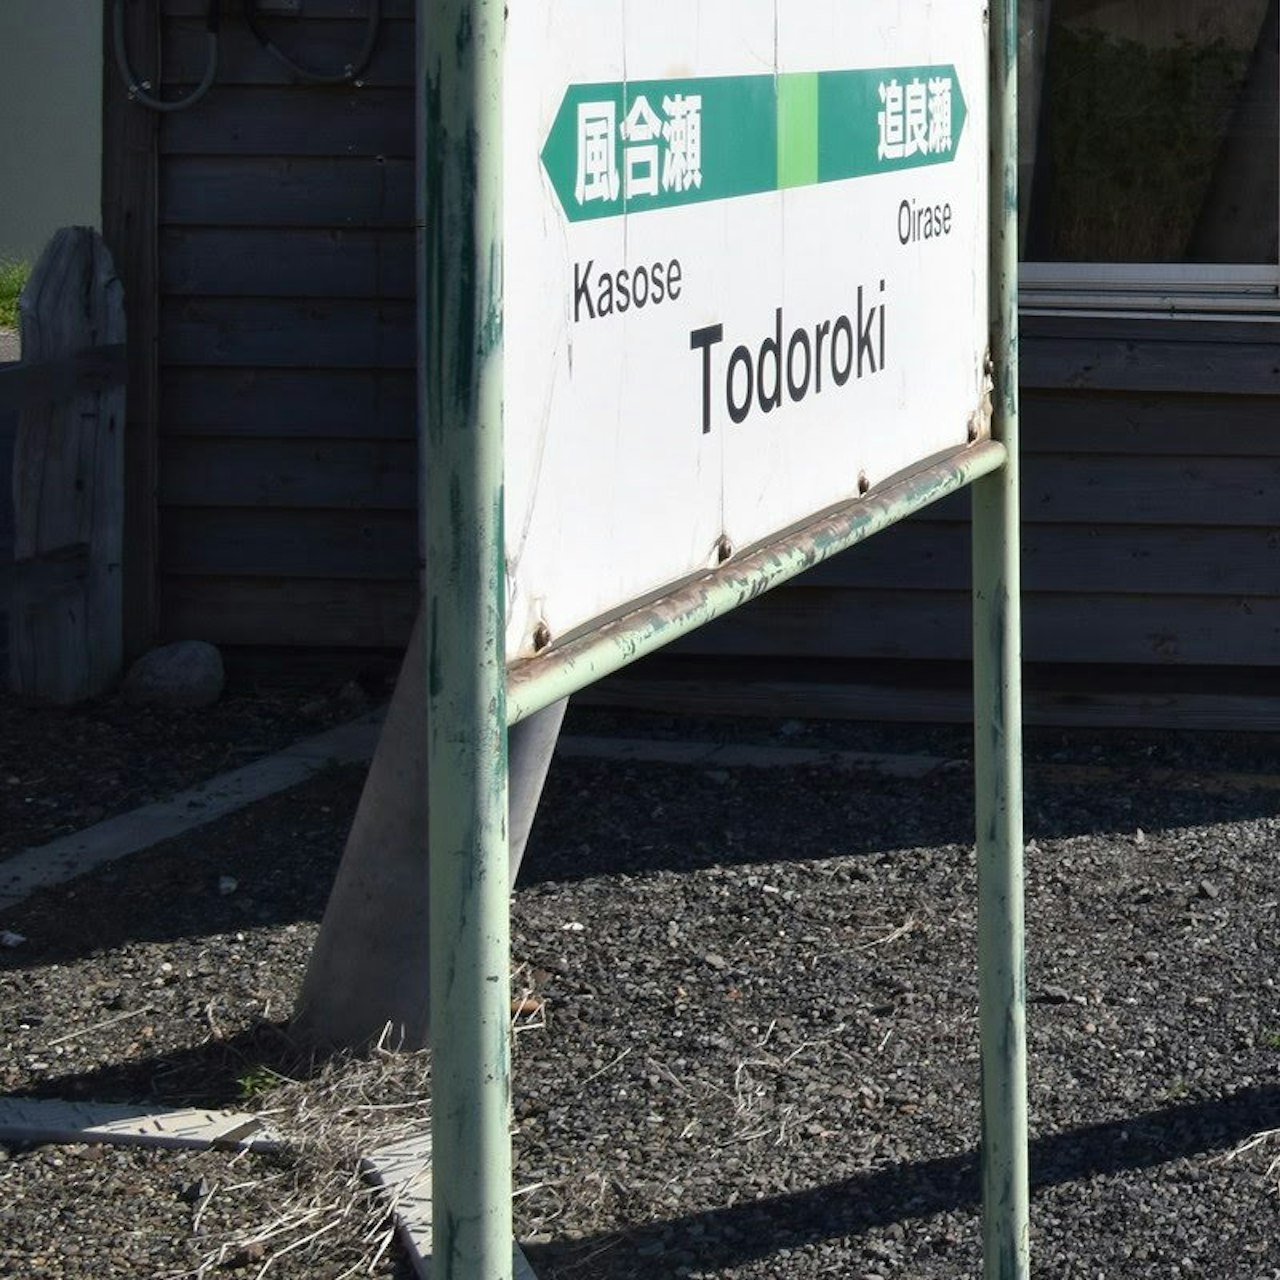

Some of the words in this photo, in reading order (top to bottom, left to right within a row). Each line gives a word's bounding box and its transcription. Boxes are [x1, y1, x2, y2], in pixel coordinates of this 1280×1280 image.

[574, 93, 703, 206] 風合瀬
[877, 77, 953, 162] 追良瀬
[897, 198, 952, 246] Oirase
[573, 258, 682, 323] Kasose
[690, 278, 886, 435] Todoroki
